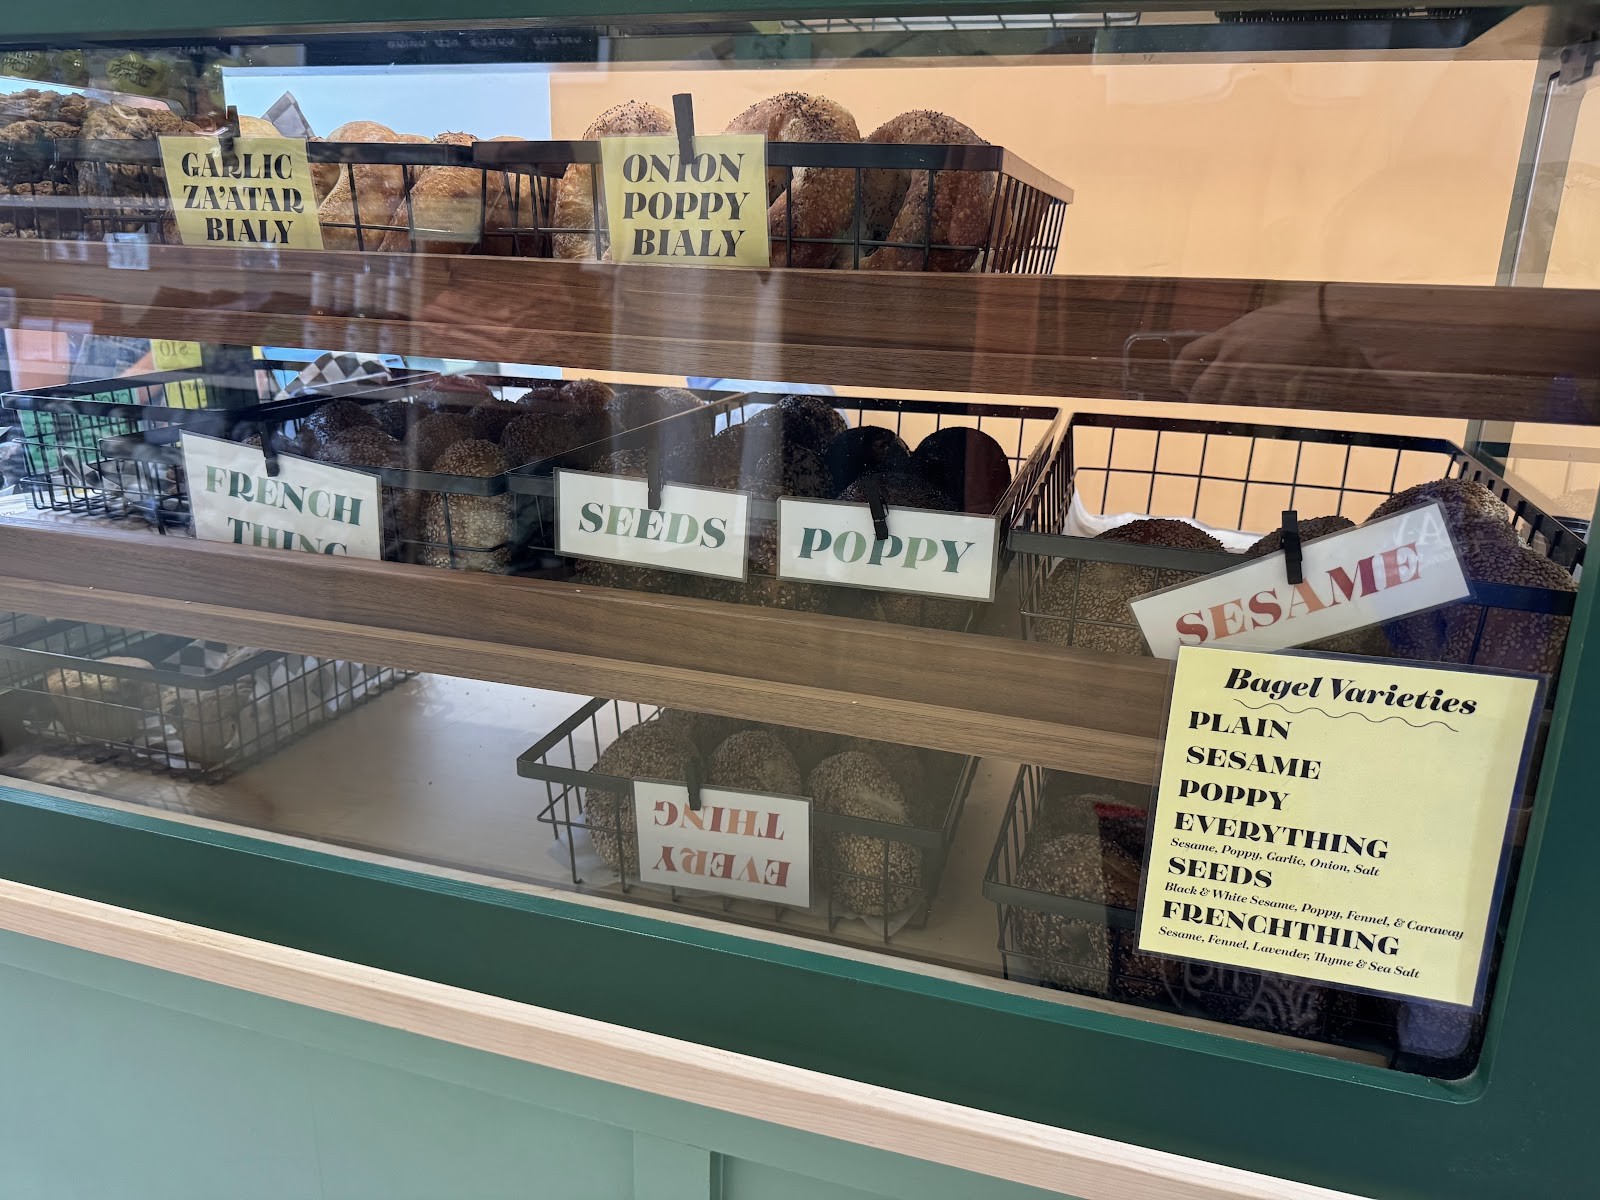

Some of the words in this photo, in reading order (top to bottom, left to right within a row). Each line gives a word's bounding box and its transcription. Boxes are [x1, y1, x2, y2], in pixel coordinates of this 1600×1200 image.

[182, 152, 293, 179] GARLIC
[622, 153, 744, 183] ONION
[184, 185, 305, 213] ZA'ATAR
[623, 192, 750, 220] POPPY
[206, 217, 293, 244] BIALY
[632, 228, 745, 257] BIALY
[205, 465, 362, 526] FRENCH
[577, 501, 728, 549] SEEDS
[798, 527, 976, 573] POPPY
[1176, 543, 1421, 644] SESAME
[1224, 668, 1323, 700] Bagel
[1331, 678, 1477, 714] Varieties
[1188, 711, 1293, 740] PLAIN
[1187, 746, 1321, 779] SESAME
[1179, 780, 1288, 810] POPPY
[654, 801, 785, 840] THING
[1175, 812, 1388, 860] EVERYTHING
[652, 846, 791, 887] EVERY
[1168, 857, 1271, 887] SEEDS
[1171, 838, 1217, 852] Sesame,
[1222, 845, 1262, 860] Poppy,
[1267, 852, 1305, 866] Garlic,
[1310, 859, 1350, 872] Onion,
[1354, 865, 1378, 876] Salt
[1162, 900, 1400, 956] FRENCHTHING
[1165, 882, 1196, 894] Black
[1200, 888, 1210, 896] &
[1214, 890, 1247, 902] White
[1250, 896, 1297, 911] Sesame,
[1302, 904, 1342, 919] Poppy,
[1347, 911, 1389, 926] Fennel,
[1394, 918, 1405, 927] &
[1407, 921, 1463, 939] Caraway
[1159, 927, 1204, 942] Sesame,
[1208, 935, 1248, 949] Fennel,
[1253, 942, 1309, 960] Lavender,
[1315, 952, 1353, 968] Thyme
[1356, 960, 1367, 968] &
[1369, 962, 1390, 973] Sea
[1394, 966, 1418, 978] Salt
